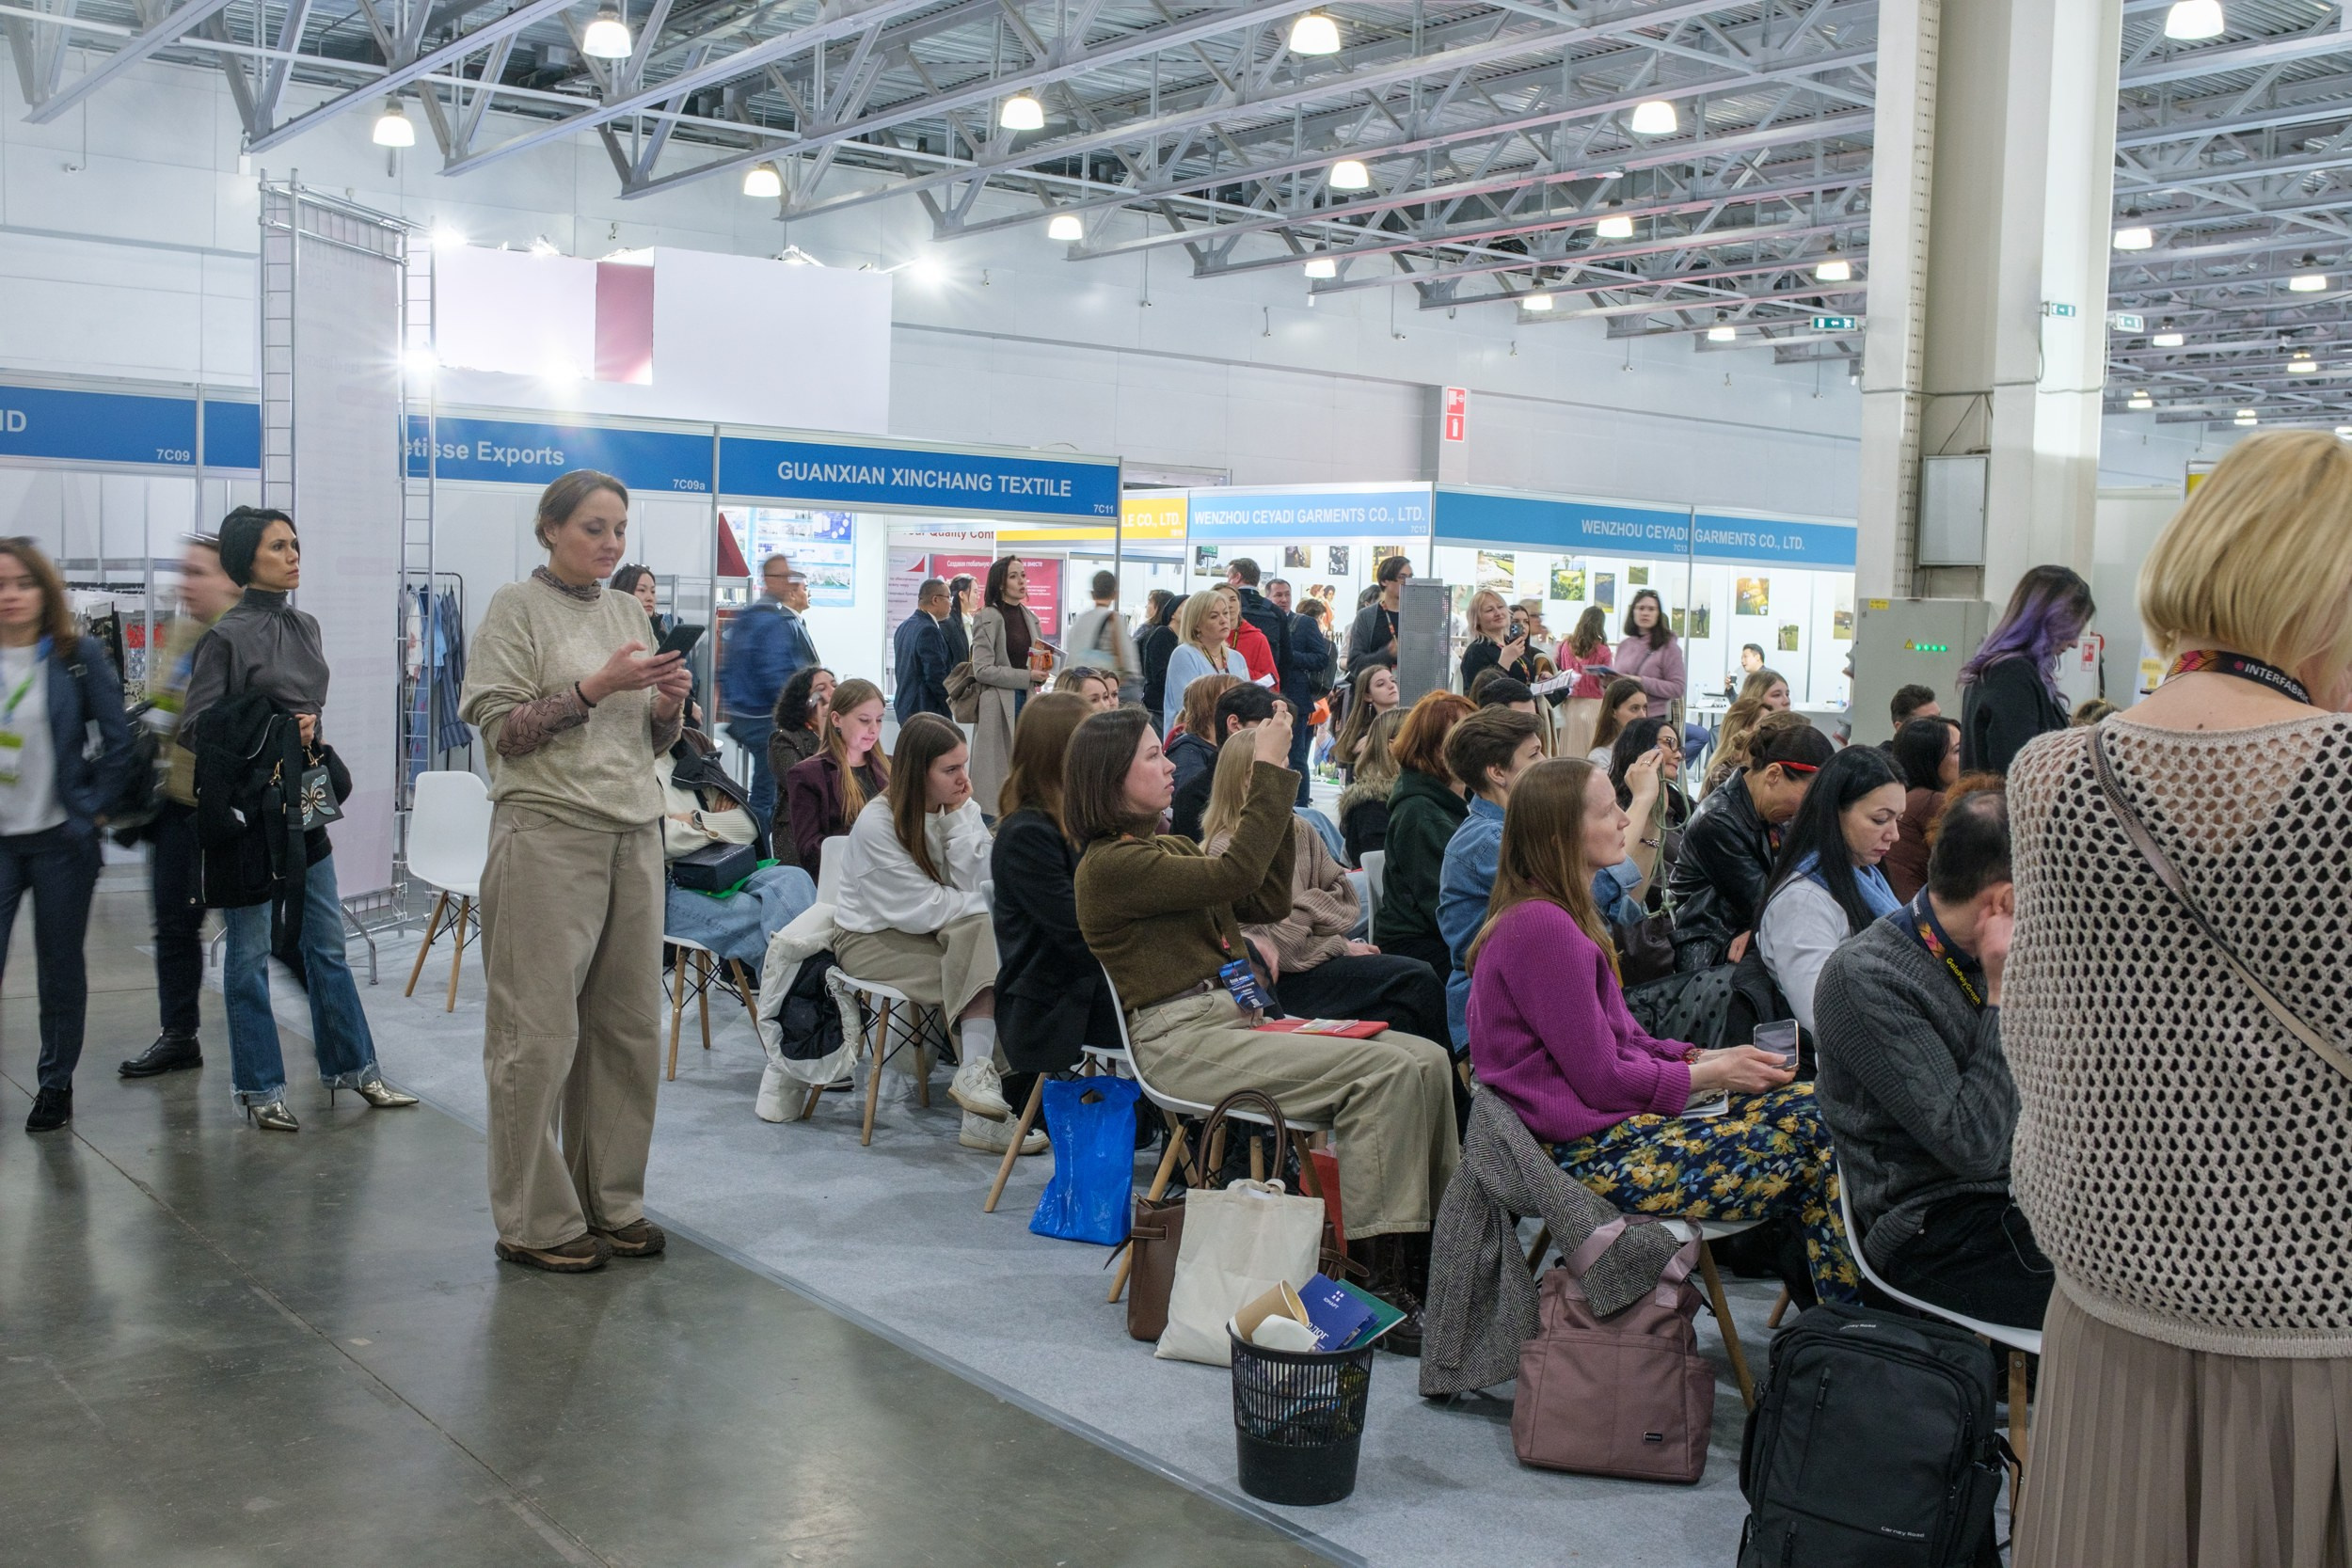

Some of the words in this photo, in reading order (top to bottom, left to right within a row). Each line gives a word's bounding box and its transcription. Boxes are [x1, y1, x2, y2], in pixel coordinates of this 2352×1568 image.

[0, 409, 27, 433] D
[156, 449, 190, 462] 7C09
[477, 440, 565, 467] Exports
[673, 479, 706, 491] 7C09a
[777, 461, 885, 485] GUANXIAN
[891, 467, 993, 492] XINCHANG
[997, 475, 1072, 498] TEXTILE
[1093, 504, 1114, 515] 7C11
[1194, 511, 1249, 525] WENZHOU
[1252, 509, 1295, 524] CEYADI
[1297, 507, 1364, 524] GARMENTS
[1369, 507, 1394, 524] CO.,
[1398, 506, 1425, 522] LTD.
[1136, 513, 1158, 529] CO.,
[1160, 512, 1182, 527] LTD.
[1581, 519, 1643, 538] WENZHOU
[1645, 524, 1689, 542] CEYADI
[1694, 529, 1756, 547] GARMENTS
[1758, 533, 1780, 550] CO.,
[1783, 536, 1805, 550] LTD.
[1673, 544, 1688, 553] 7C13
[1881, 1526, 1906, 1537] Carney
